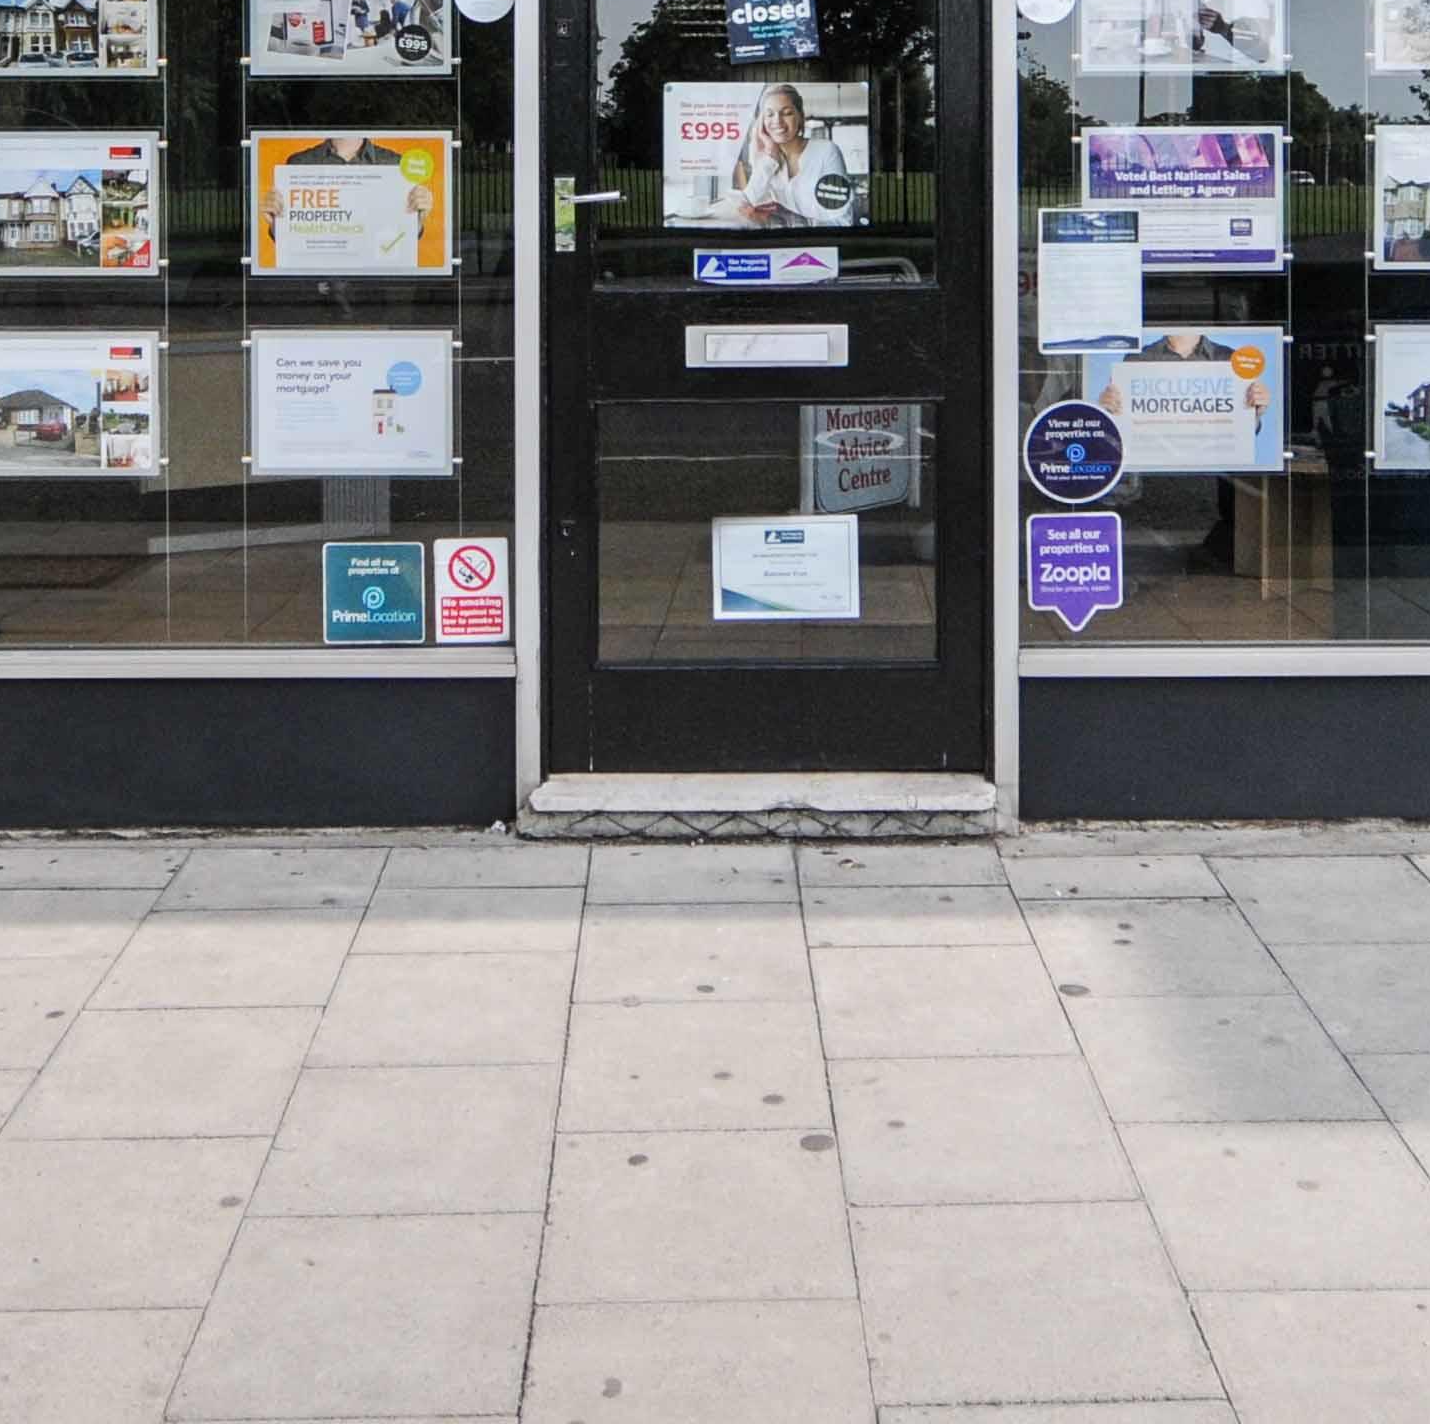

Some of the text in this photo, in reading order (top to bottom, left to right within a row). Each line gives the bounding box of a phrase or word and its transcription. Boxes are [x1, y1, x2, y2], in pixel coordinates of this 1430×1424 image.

[398, 38, 428, 51] £995
[681, 121, 741, 141] £995
[1114, 170, 1251, 182] Voted Best National Sales
[1129, 184, 1237, 198] and Lettings Agency
[289, 189, 340, 208] FREE
[289, 210, 353, 222] PROPERTY
[276, 358, 362, 370] Can we save you
[276, 373, 352, 383] money on your
[276, 383, 332, 395] mortgage?
[1131, 378, 1235, 396] EXCLUSIVE
[1131, 398, 1234, 413] MORTGAGES
[826, 405, 899, 432] Mortgage
[1047, 419, 1102, 429] View all our
[1045, 429, 1106, 440] properties on
[837, 437, 892, 464] Advice
[1039, 462, 1112, 474] PrimeLocation
[838, 466, 892, 493] Centre
[1047, 528, 1101, 540] See all our
[1039, 543, 1110, 557] properties on
[350, 557, 369, 567] Find
[370, 557, 381, 567] all
[347, 567, 388, 577] properties
[1040, 563, 1111, 586] Zoopla
[442, 598, 502, 608] No smoking
[331, 609, 416, 624] PrimeLocation
